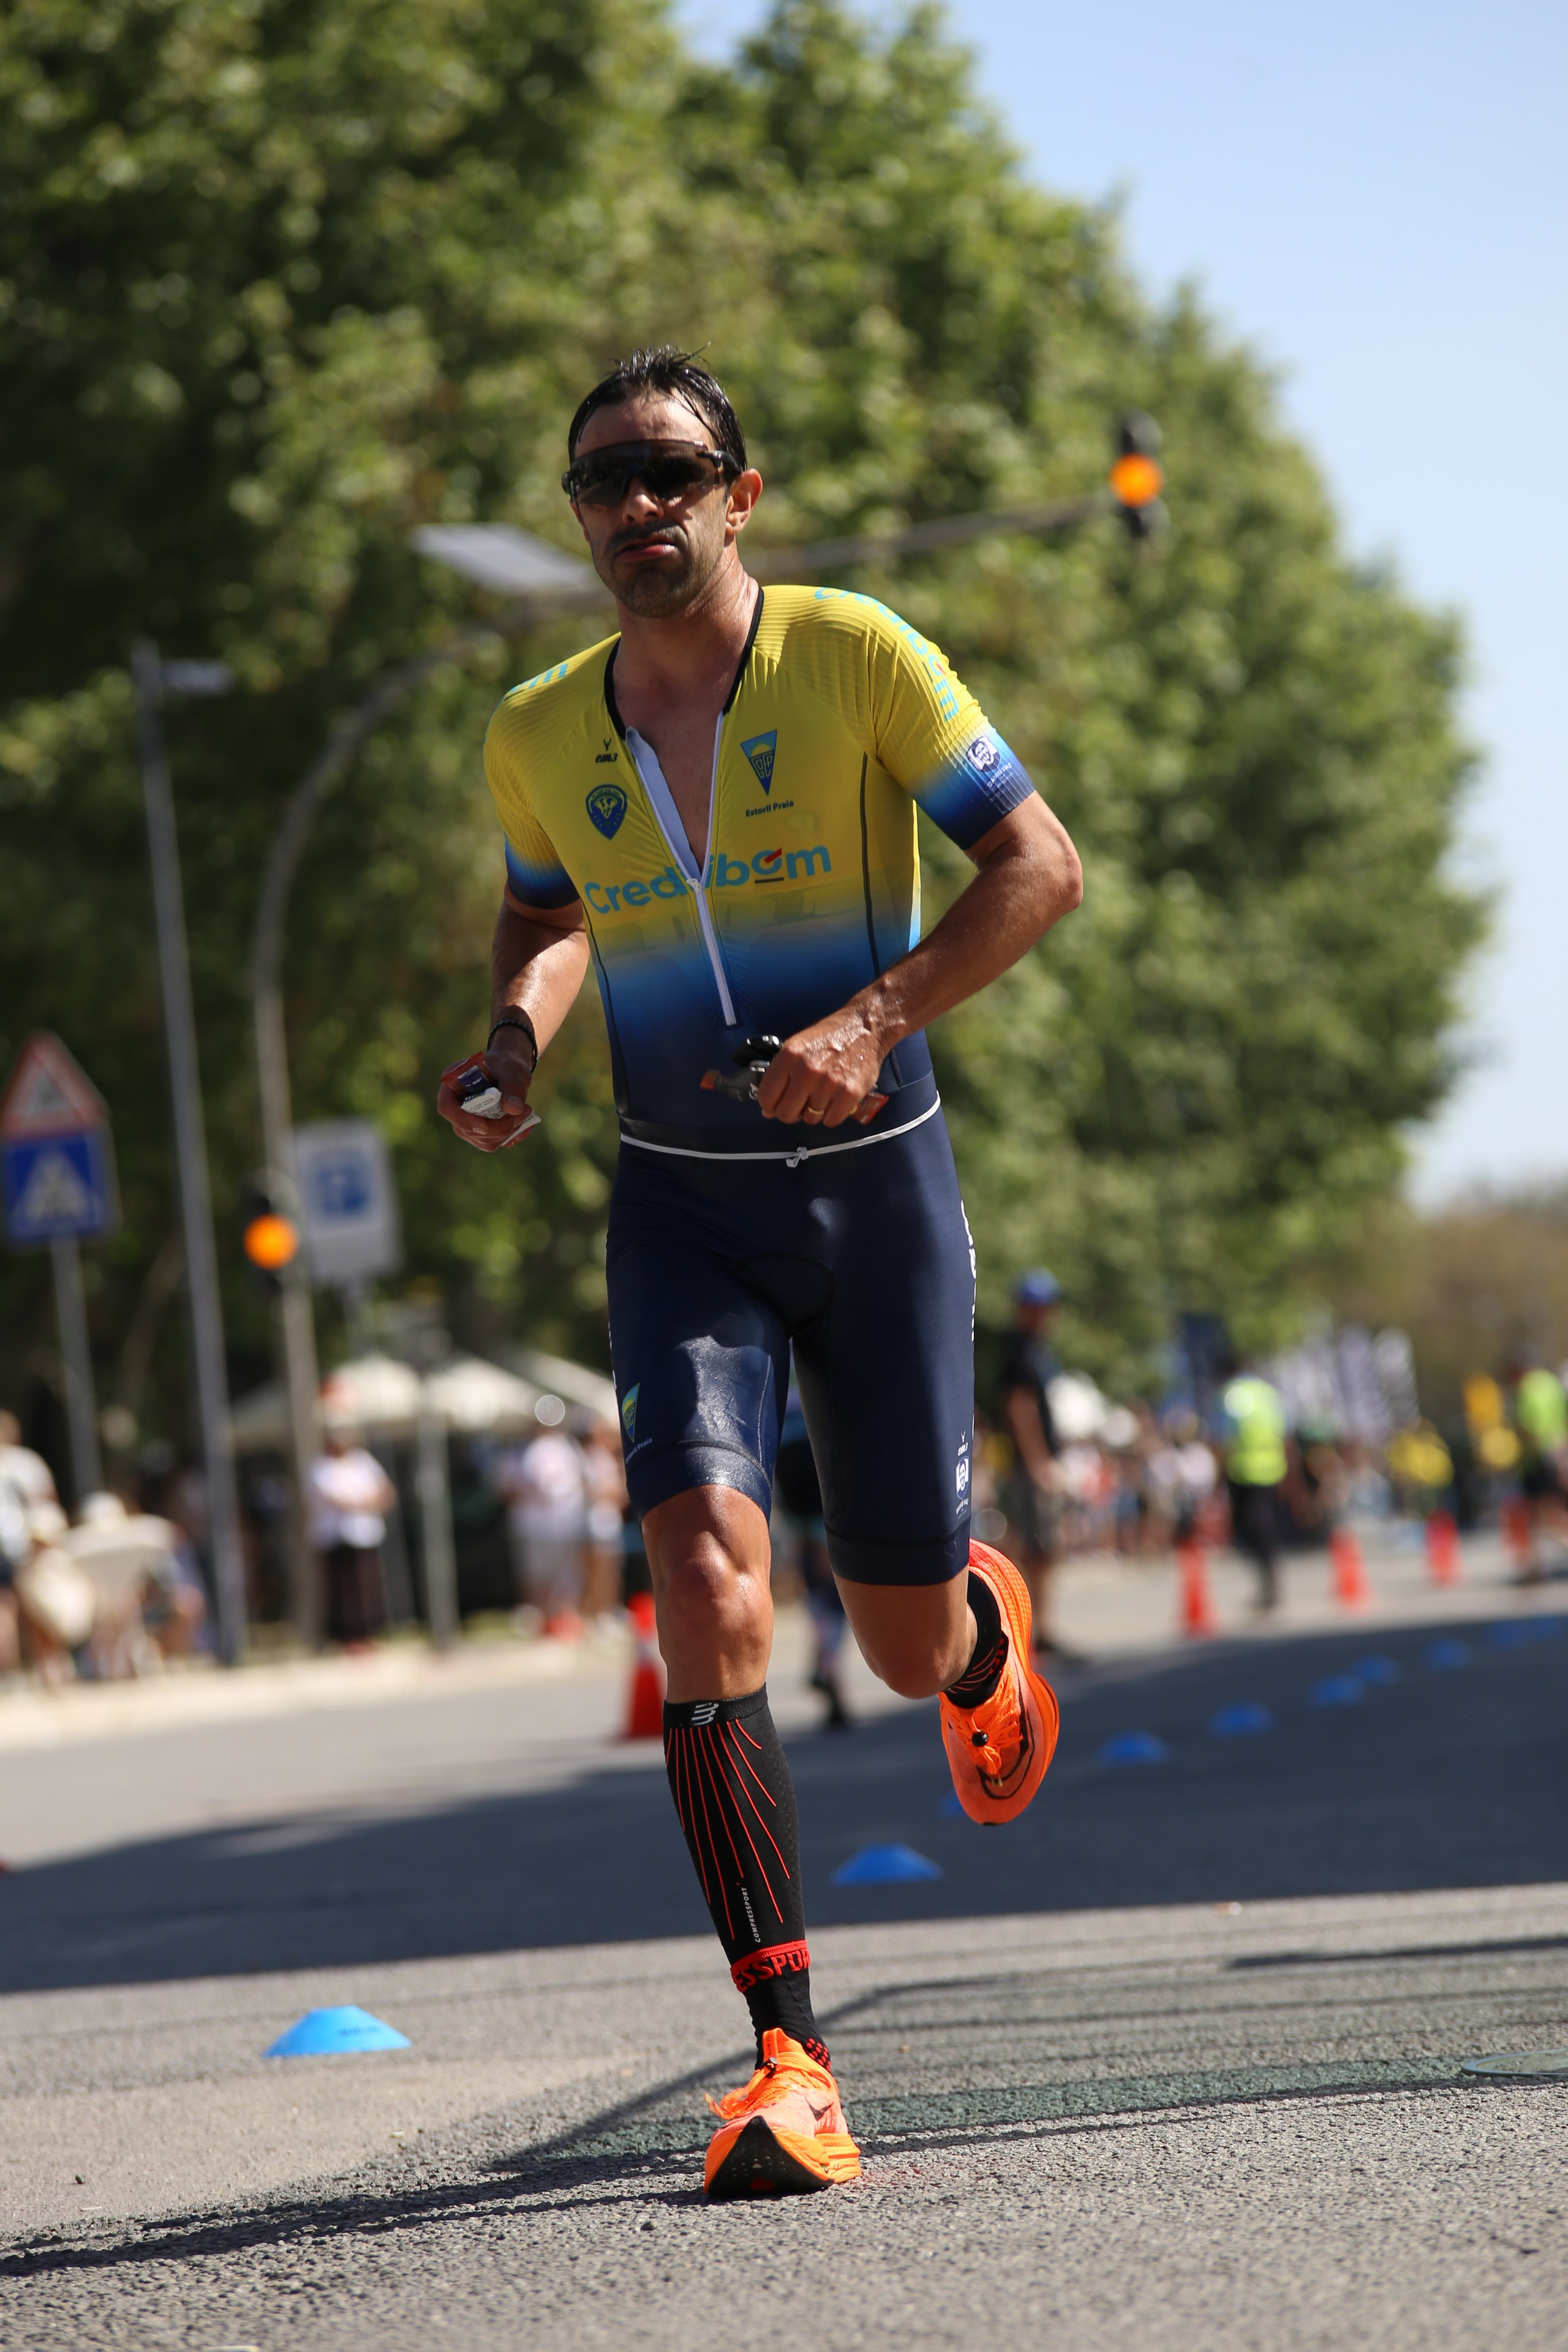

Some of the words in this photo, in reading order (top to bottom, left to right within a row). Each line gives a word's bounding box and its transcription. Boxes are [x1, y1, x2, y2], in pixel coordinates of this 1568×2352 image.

[745, 804, 771, 817] Estoril
[773, 799, 794, 810] Praia
[584, 845, 832, 914] Credibom
[741, 1887, 761, 1943] COMPRESSPORT
